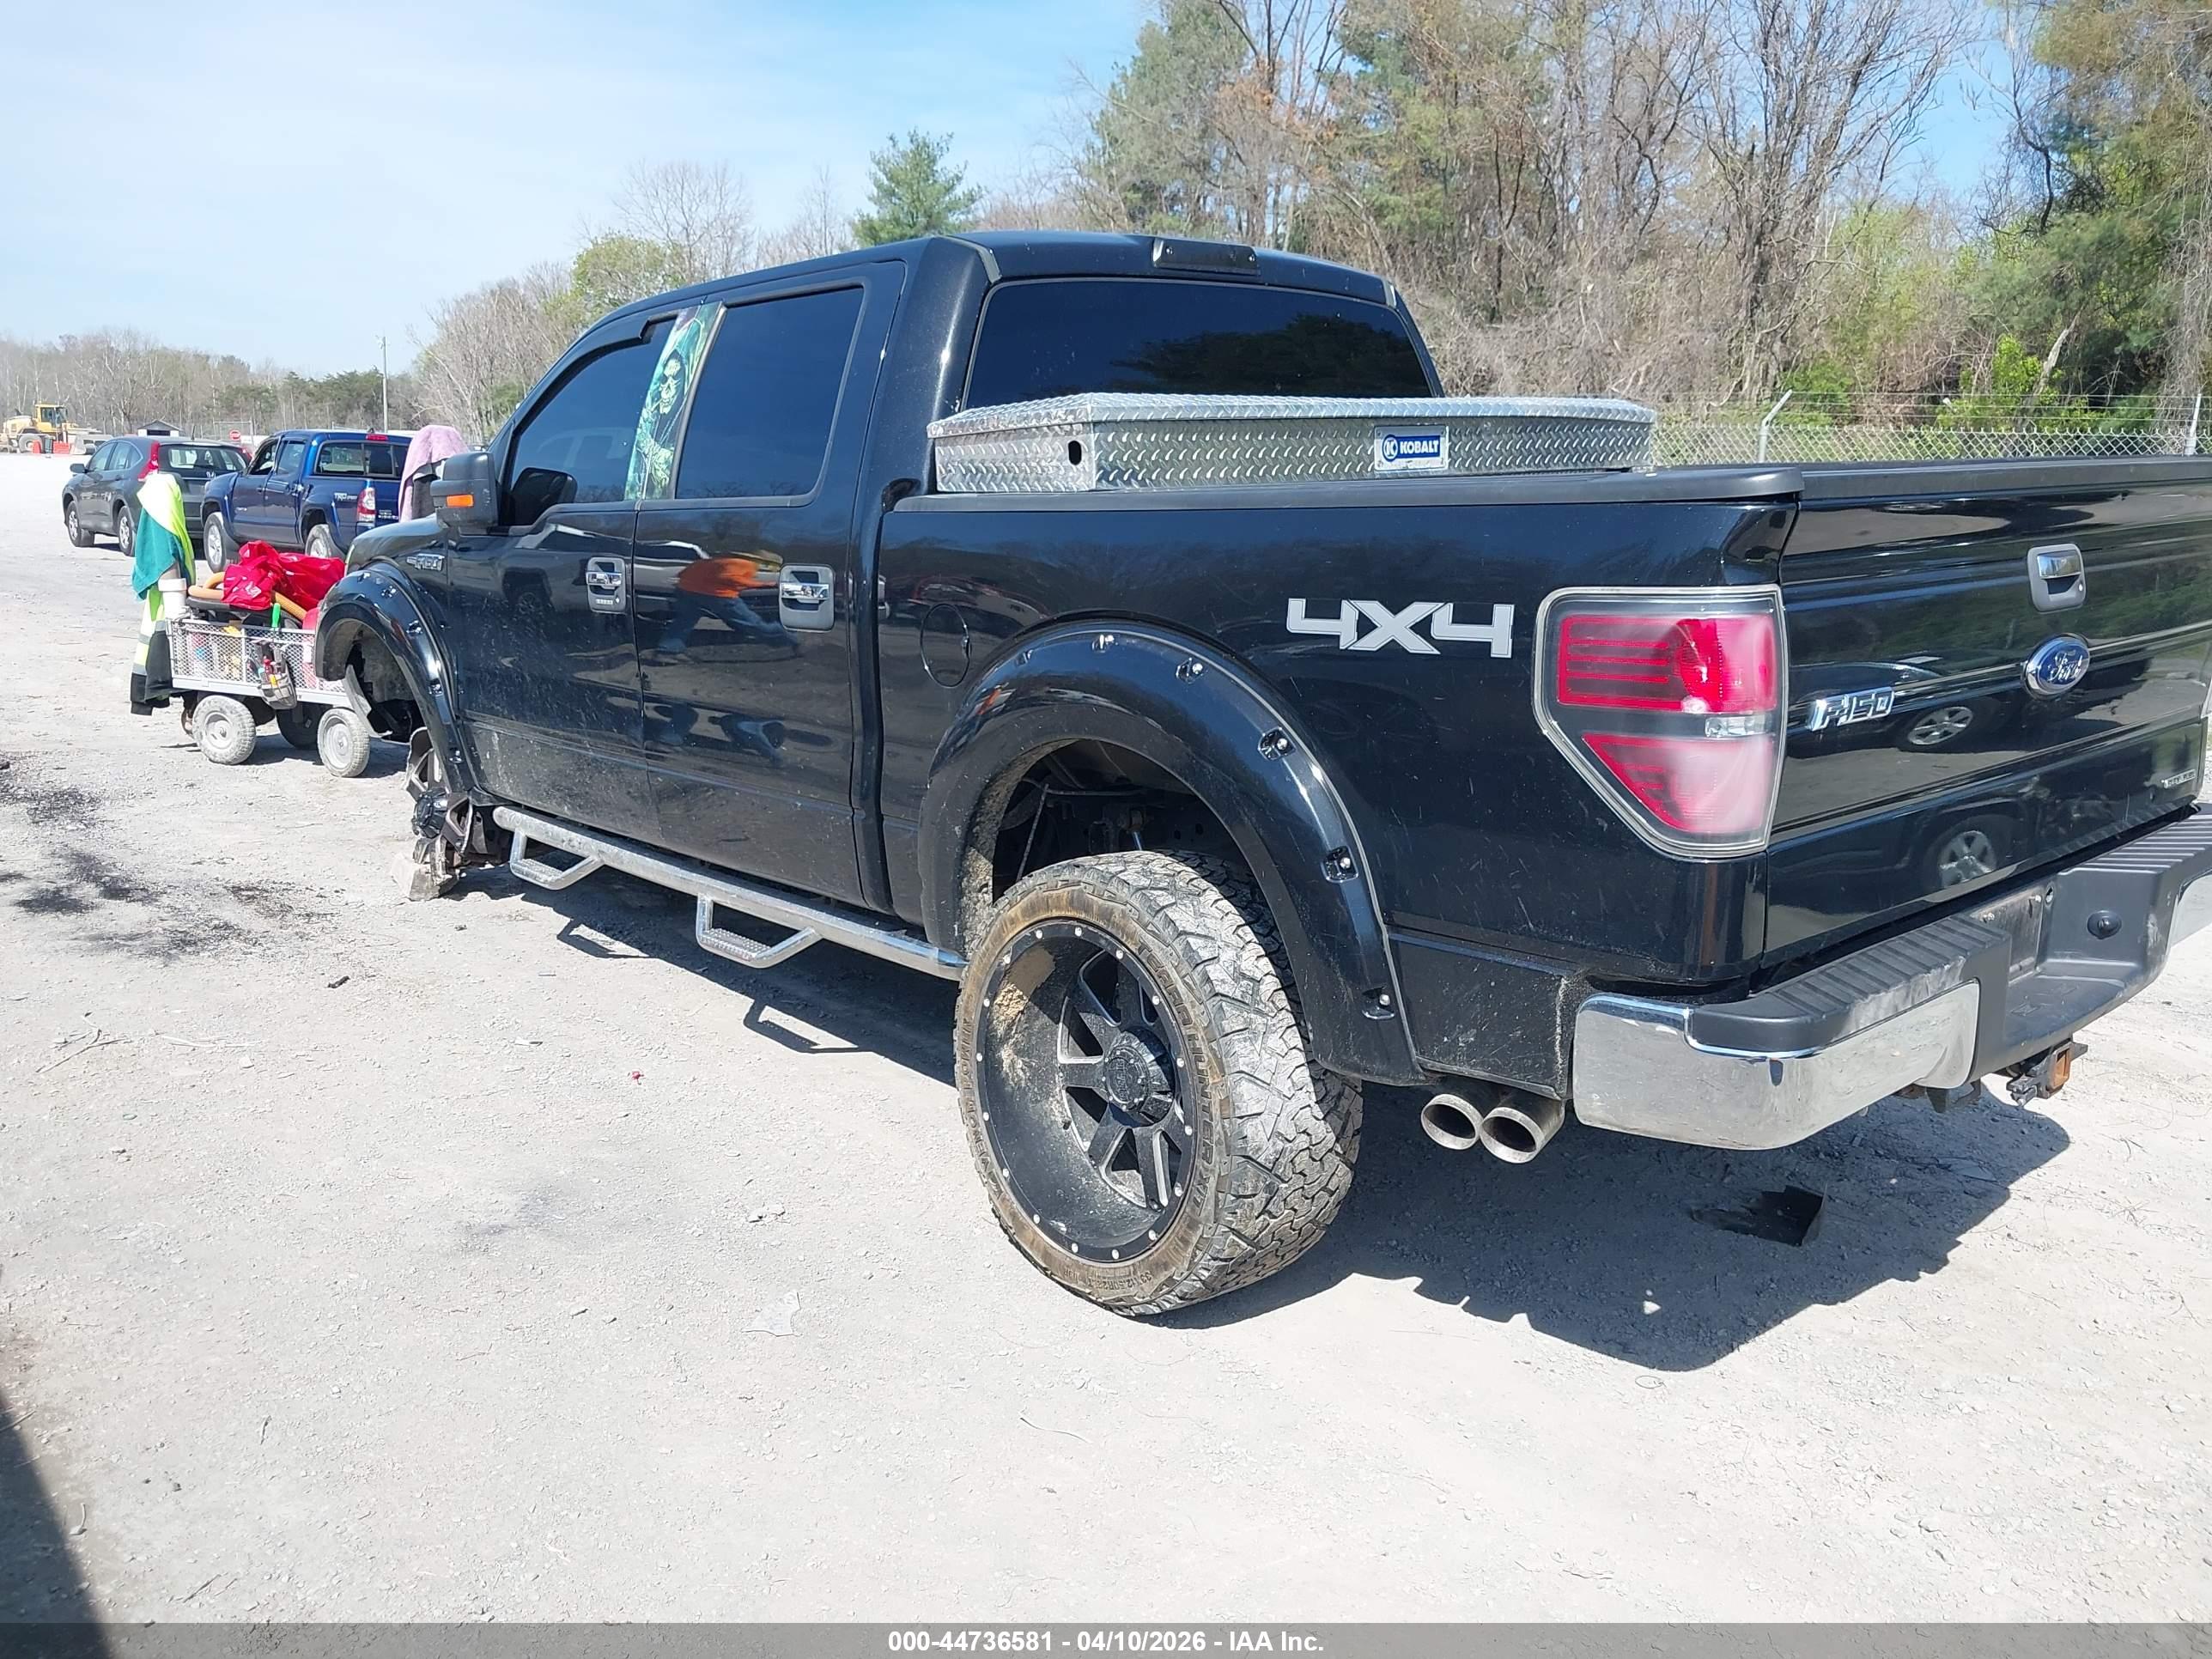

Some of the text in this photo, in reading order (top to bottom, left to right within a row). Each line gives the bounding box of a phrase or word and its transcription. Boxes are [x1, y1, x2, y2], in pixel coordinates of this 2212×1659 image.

[1400, 440, 1439, 454] KOBALT
[2048, 651, 2082, 684] Ford
[1188, 1034, 1214, 1165] HUNTER
